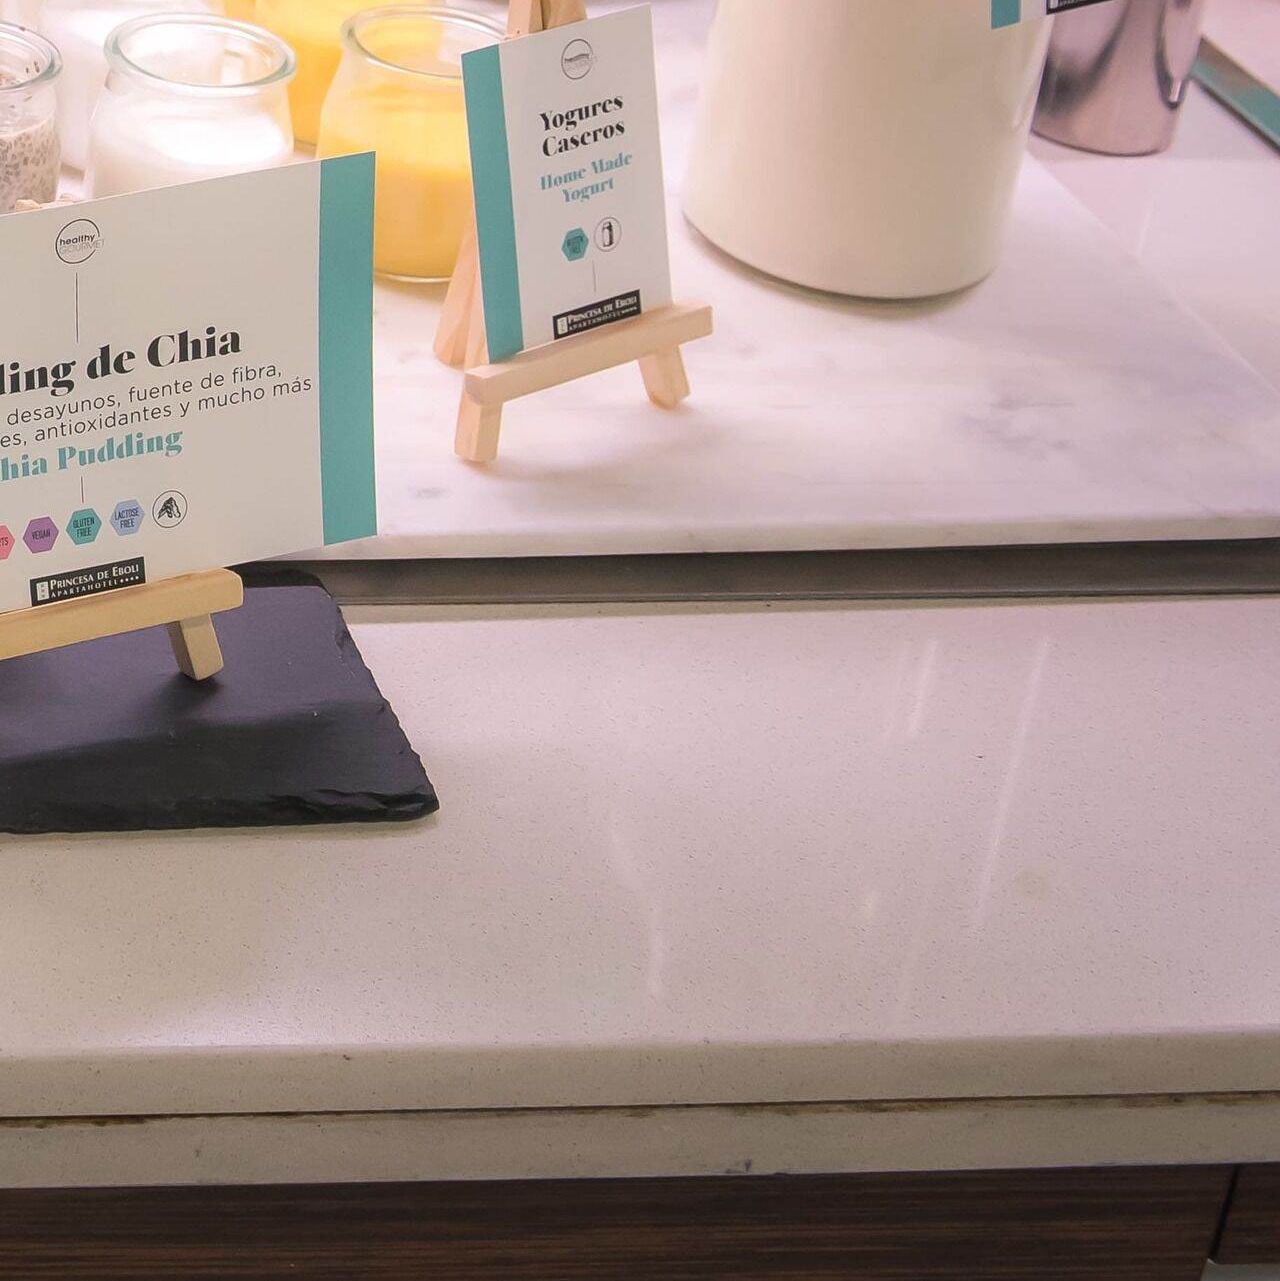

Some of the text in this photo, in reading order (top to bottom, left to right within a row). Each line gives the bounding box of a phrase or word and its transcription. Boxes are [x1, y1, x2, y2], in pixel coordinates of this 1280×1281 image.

[540, 95, 624, 132] Yogures
[542, 121, 626, 157] Caseros
[540, 152, 633, 191] Home Made
[562, 177, 615, 203] Yogurt
[59, 234, 96, 246] healthy
[86, 343, 136, 380] de
[147, 326, 242, 367] Chia
[7, 393, 122, 426] desayunos,
[128, 380, 193, 403] fuente
[200, 373, 225, 390] de
[232, 364, 282, 384] fibra,
[34, 403, 172, 441] antioxidantes
[179, 401, 191, 418] y
[198, 386, 265, 411] mucho
[272, 376, 313, 397] más
[57, 431, 184, 470] Pudding
[72, 517, 95, 528] GLUTEN
[114, 507, 140, 520] LACTOSE
[120, 519, 135, 529] FREE
[31, 529, 51, 541] VEGAN
[76, 527, 92, 537] FREE
[50, 563, 139, 590] PRINCESA DE EBOLI
[51, 579, 118, 598] APARTAHOTEL
